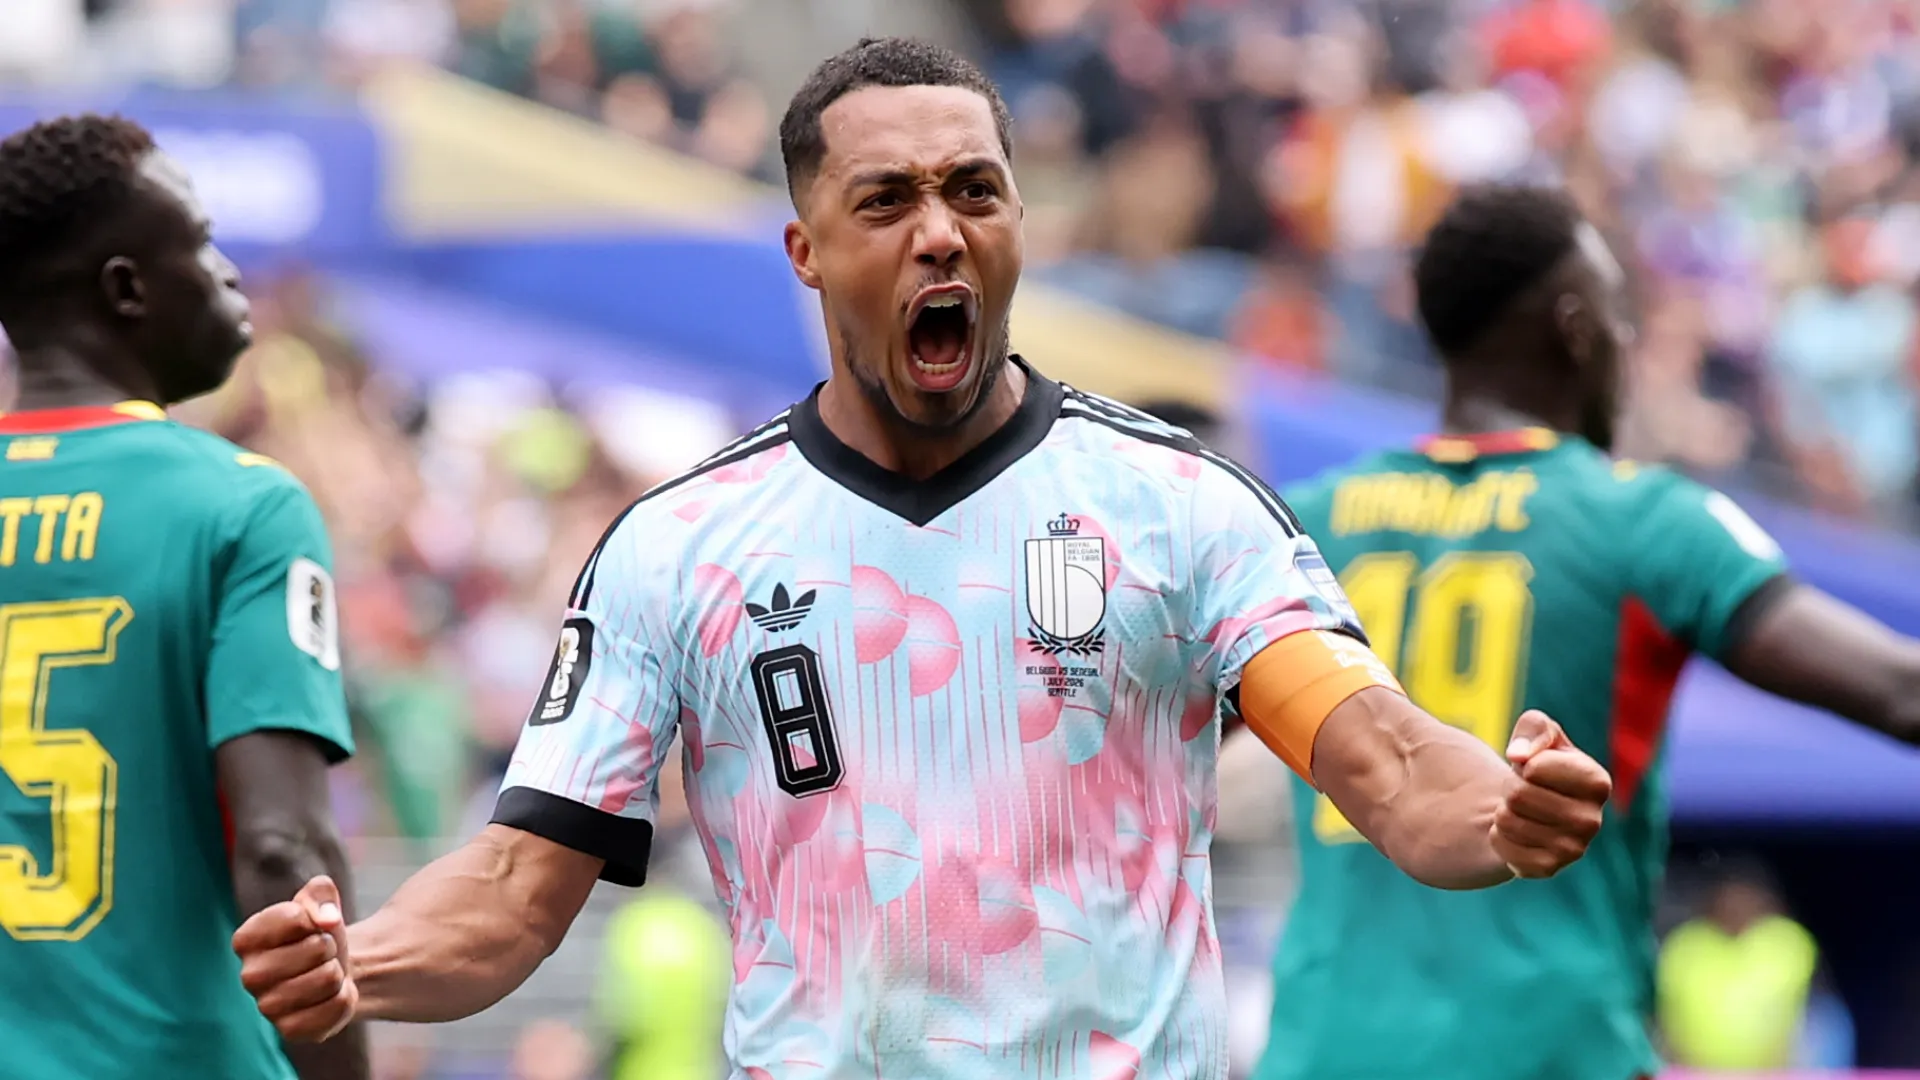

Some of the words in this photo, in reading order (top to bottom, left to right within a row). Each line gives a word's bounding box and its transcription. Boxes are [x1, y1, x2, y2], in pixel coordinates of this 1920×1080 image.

[0, 491, 104, 567] TTA
[751, 643, 846, 798] 8
[1047, 687, 1077, 697] SEATTLE
[1064, 677, 1084, 687] 2026
[1313, 551, 1535, 844] 19
[0, 596, 135, 942] 5
